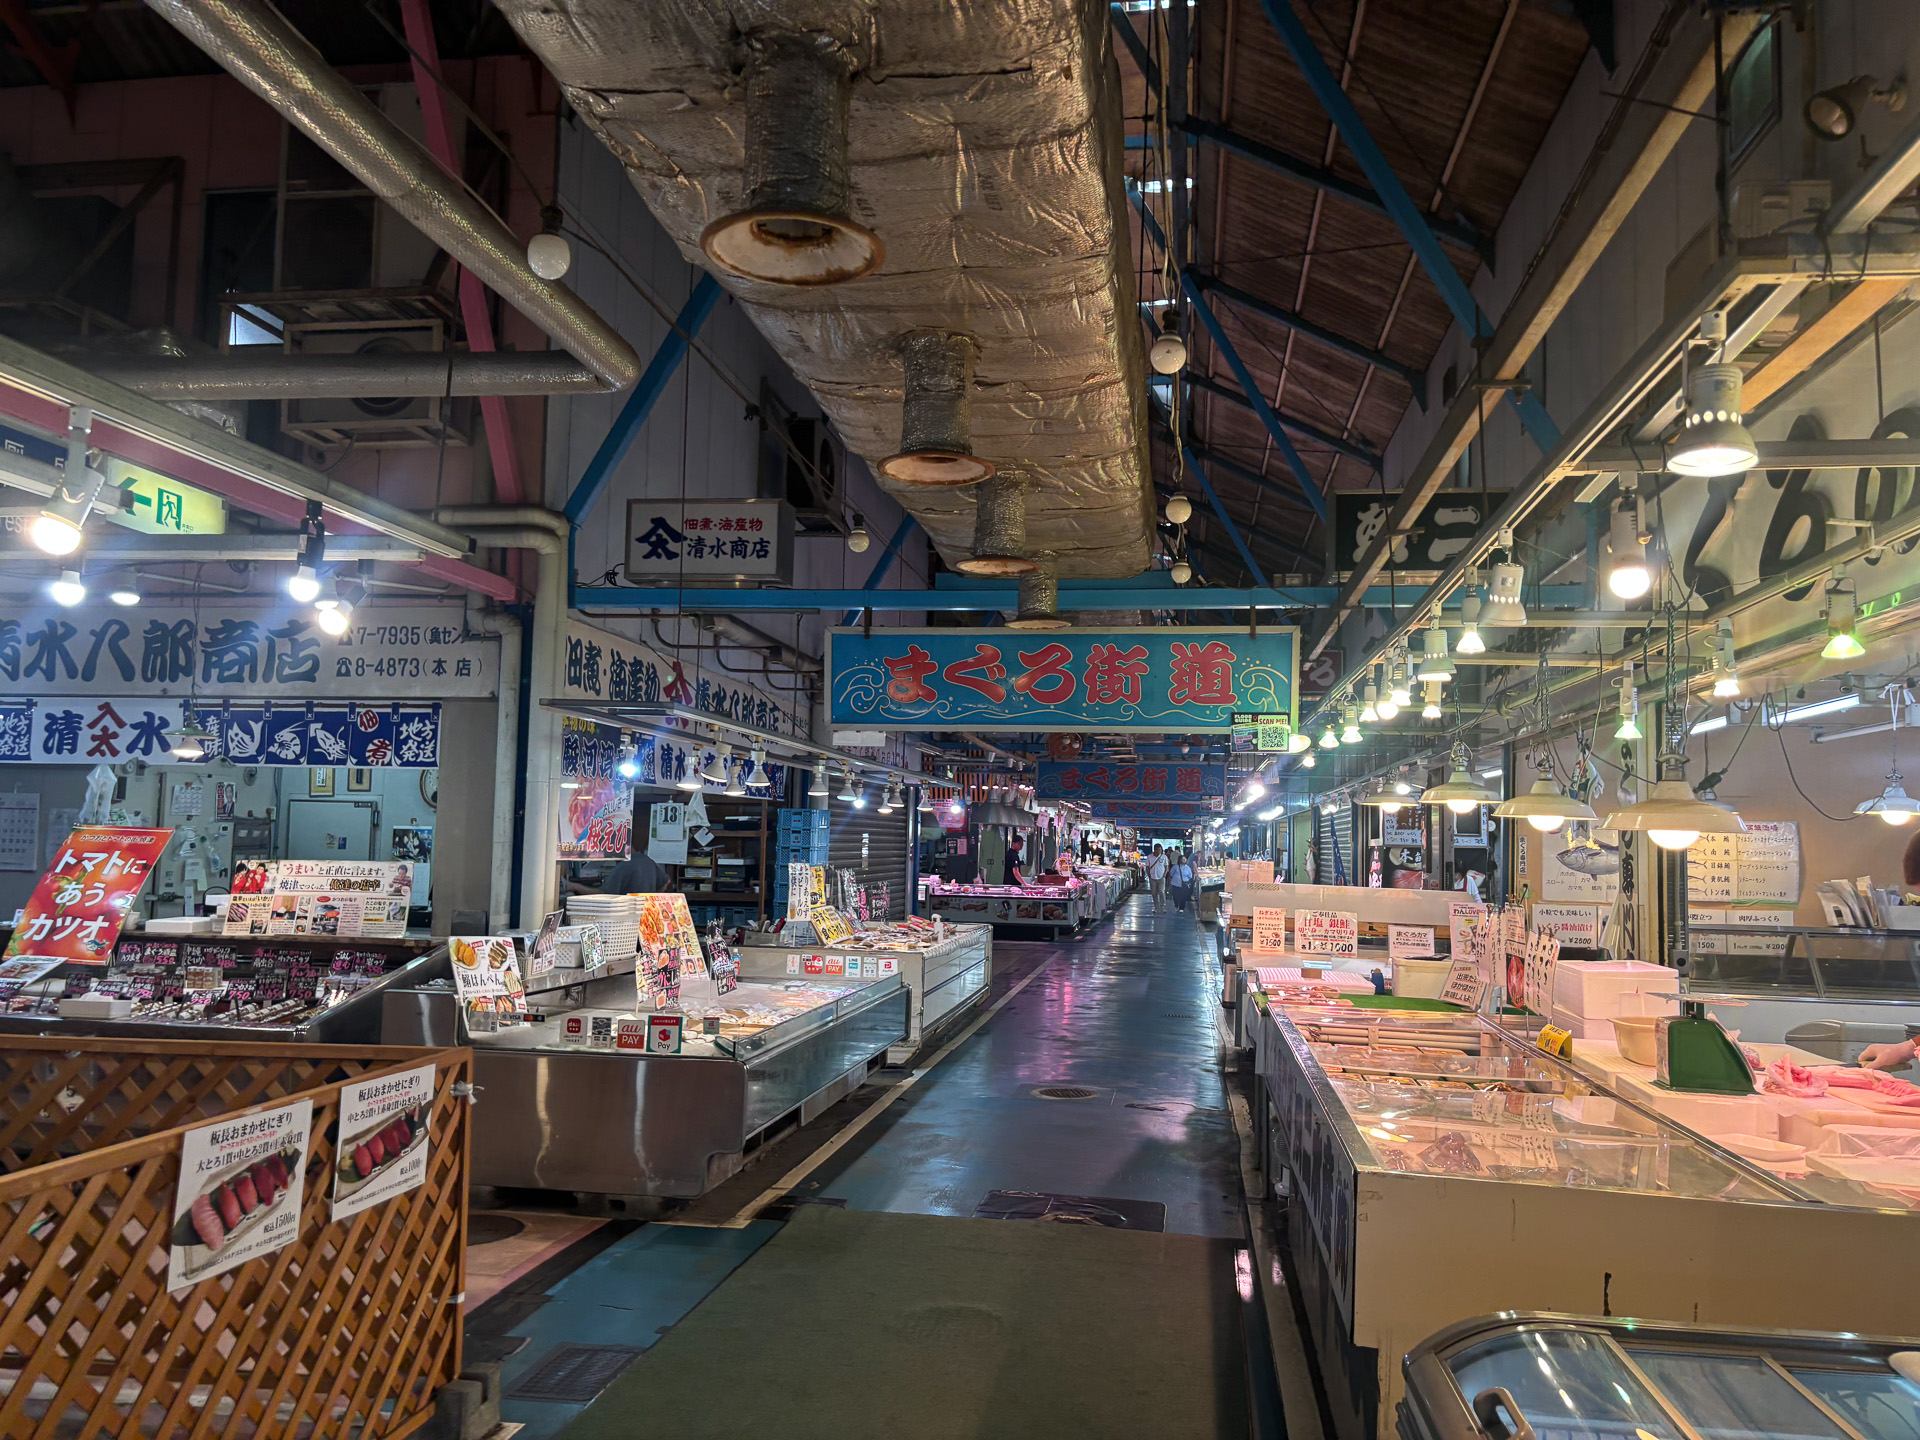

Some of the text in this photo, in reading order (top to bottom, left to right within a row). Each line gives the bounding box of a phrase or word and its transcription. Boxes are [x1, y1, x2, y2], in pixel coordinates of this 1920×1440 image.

[684, 518, 762, 532] 佃煮・海産物
[687, 537, 771, 560] 清水商店
[883, 641, 1237, 706] まぐろ街道
[400, 717, 435, 740] 地方
[400, 740, 436, 763] 発送
[1059, 766, 1204, 794] まぐろ街道
[662, 806, 678, 823] 13
[586, 817, 628, 853] 桜えび
[54, 848, 147, 876] トマトに
[54, 882, 106, 907] あう
[22, 914, 110, 942] カツオ
[1304, 917, 1324, 928] 甘塩
[621, 1023, 641, 1033] au
[622, 1035, 640, 1045] PAY
[657, 1041, 671, 1050] Pay
[358, 1075, 421, 1103] 板長おまかせにぎり
[210, 1112, 292, 1147] 板長おまかせにぎり
